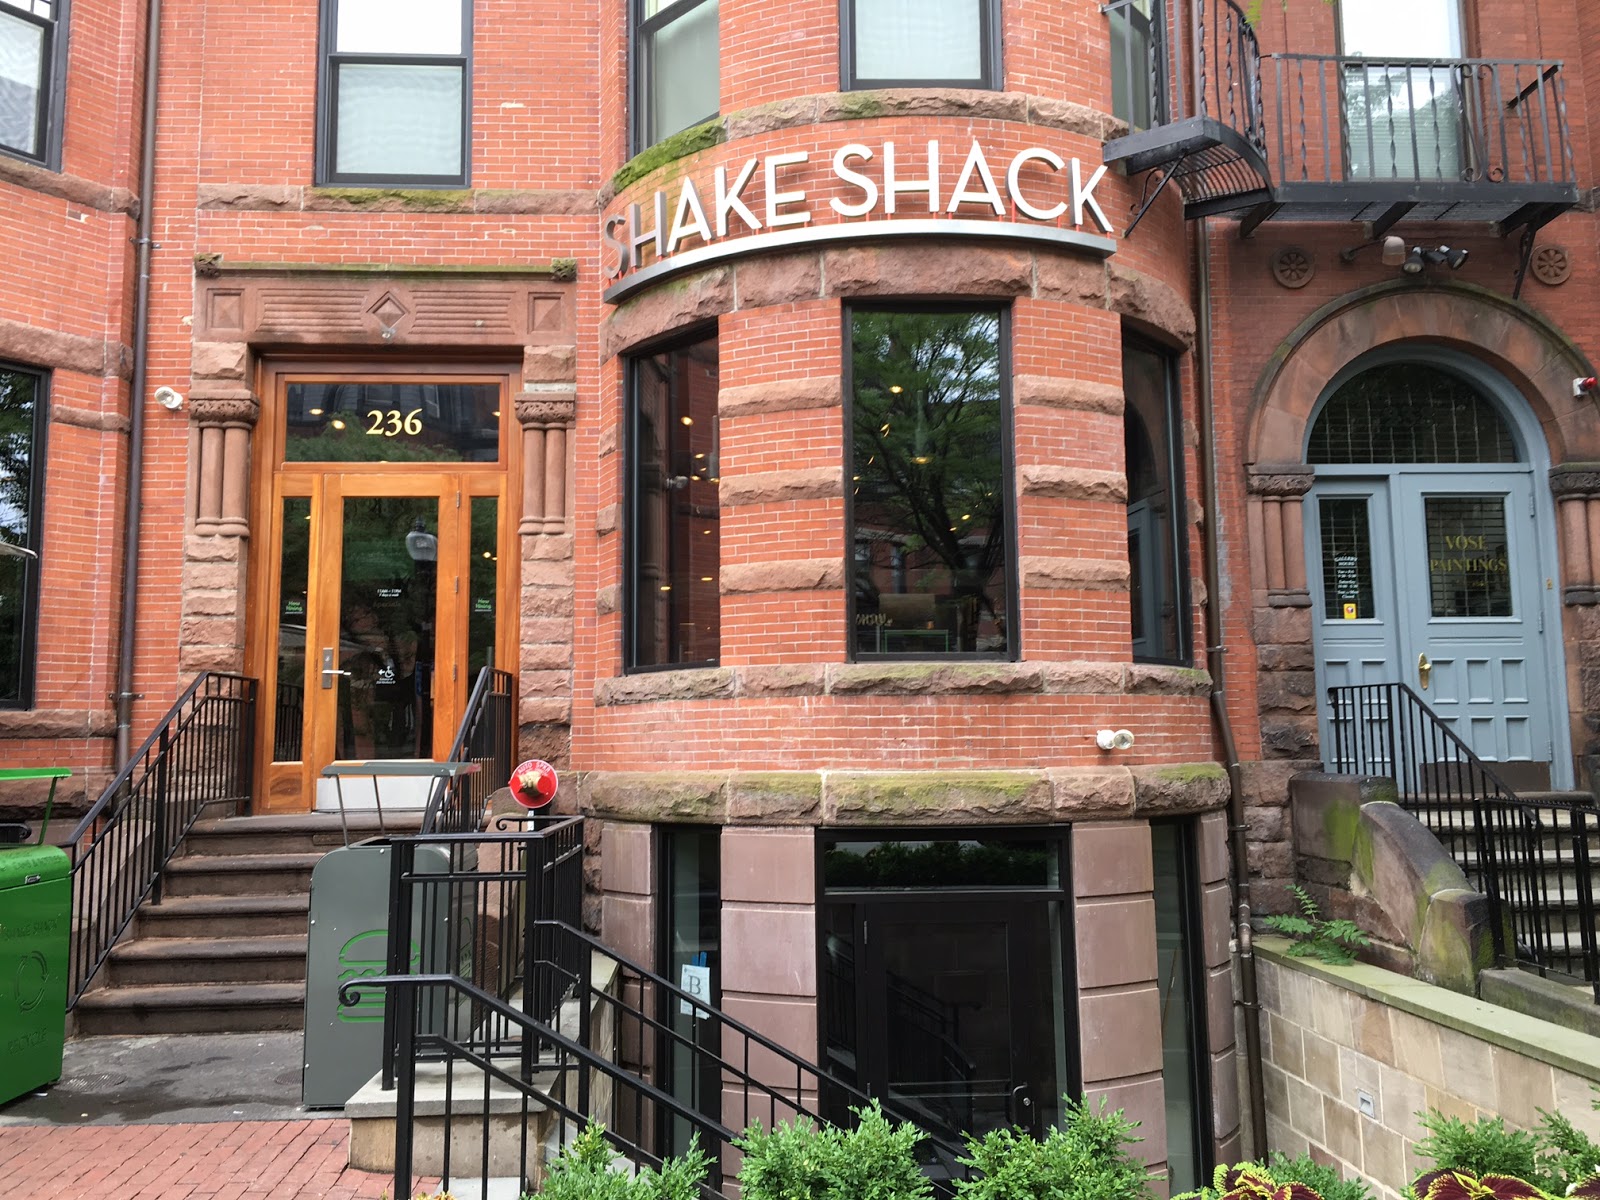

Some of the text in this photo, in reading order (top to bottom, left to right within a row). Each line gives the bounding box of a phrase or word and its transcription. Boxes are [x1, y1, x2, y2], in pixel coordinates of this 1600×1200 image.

[603, 139, 1114, 279] SHAKE SHACK
[366, 408, 423, 437] 236
[1445, 535, 1488, 550] VOSE
[1429, 558, 1507, 572] PAINTINGS
[518, 762, 532, 774] AUTO
[688, 975, 702, 995] B
